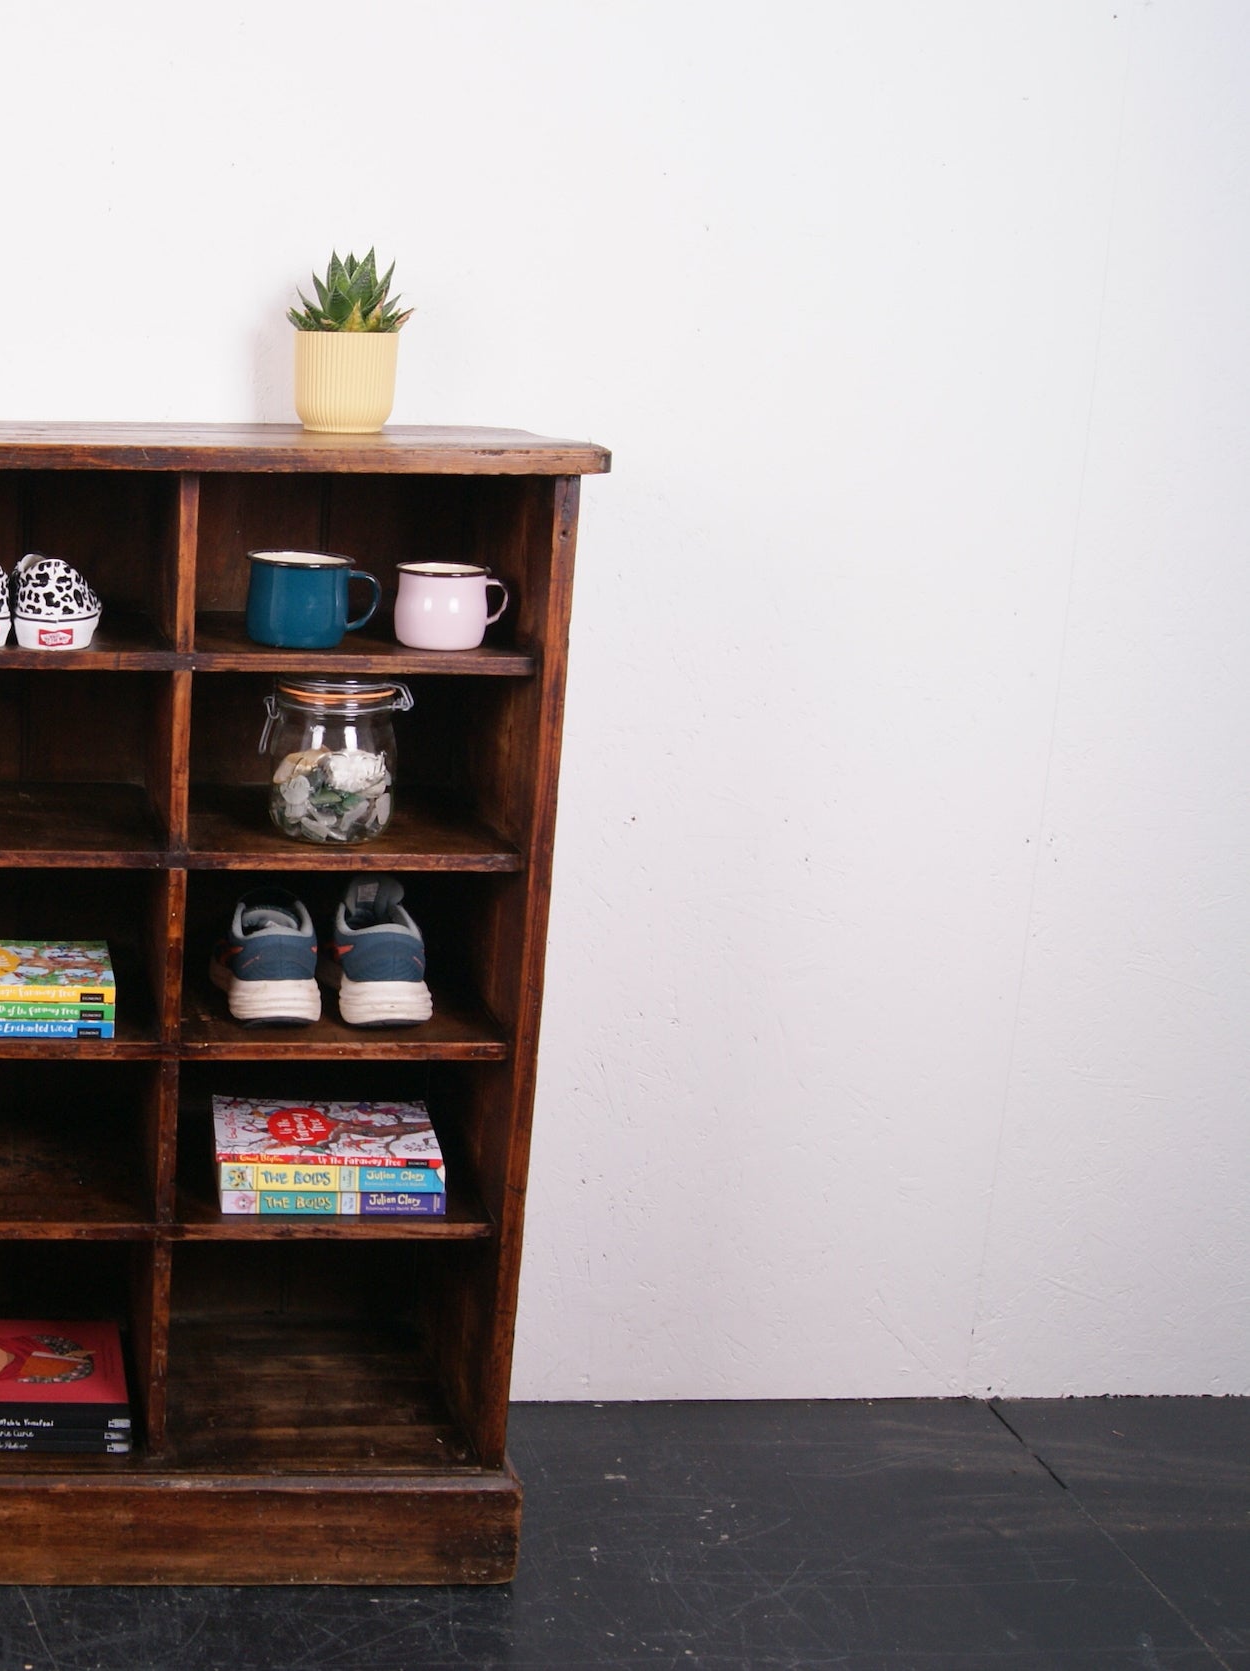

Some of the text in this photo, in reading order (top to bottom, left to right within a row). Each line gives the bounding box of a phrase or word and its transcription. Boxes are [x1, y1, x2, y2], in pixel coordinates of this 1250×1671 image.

[7, 1006, 16, 1016] of
[28, 1006, 60, 1017] Faraway
[61, 1007, 79, 1016] Tree
[3, 1023, 49, 1033] Enchanted
[50, 1023, 74, 1033] Wood
[291, 1113, 314, 1141] Faraway
[308, 1118, 327, 1133] Tree
[260, 1153, 285, 1162] Blyton
[344, 1157, 382, 1166] Faraway
[384, 1158, 401, 1166] Tree
[261, 1170, 289, 1185] THE
[293, 1170, 331, 1186] BOLDS
[366, 1170, 396, 1180] Julian
[400, 1170, 426, 1182] Clary
[264, 1196, 290, 1210] THE
[294, 1196, 332, 1211] BOLDS
[369, 1194, 397, 1206] Julian
[397, 1194, 422, 1207] Clary
[13, 1430, 34, 1438] Curie
